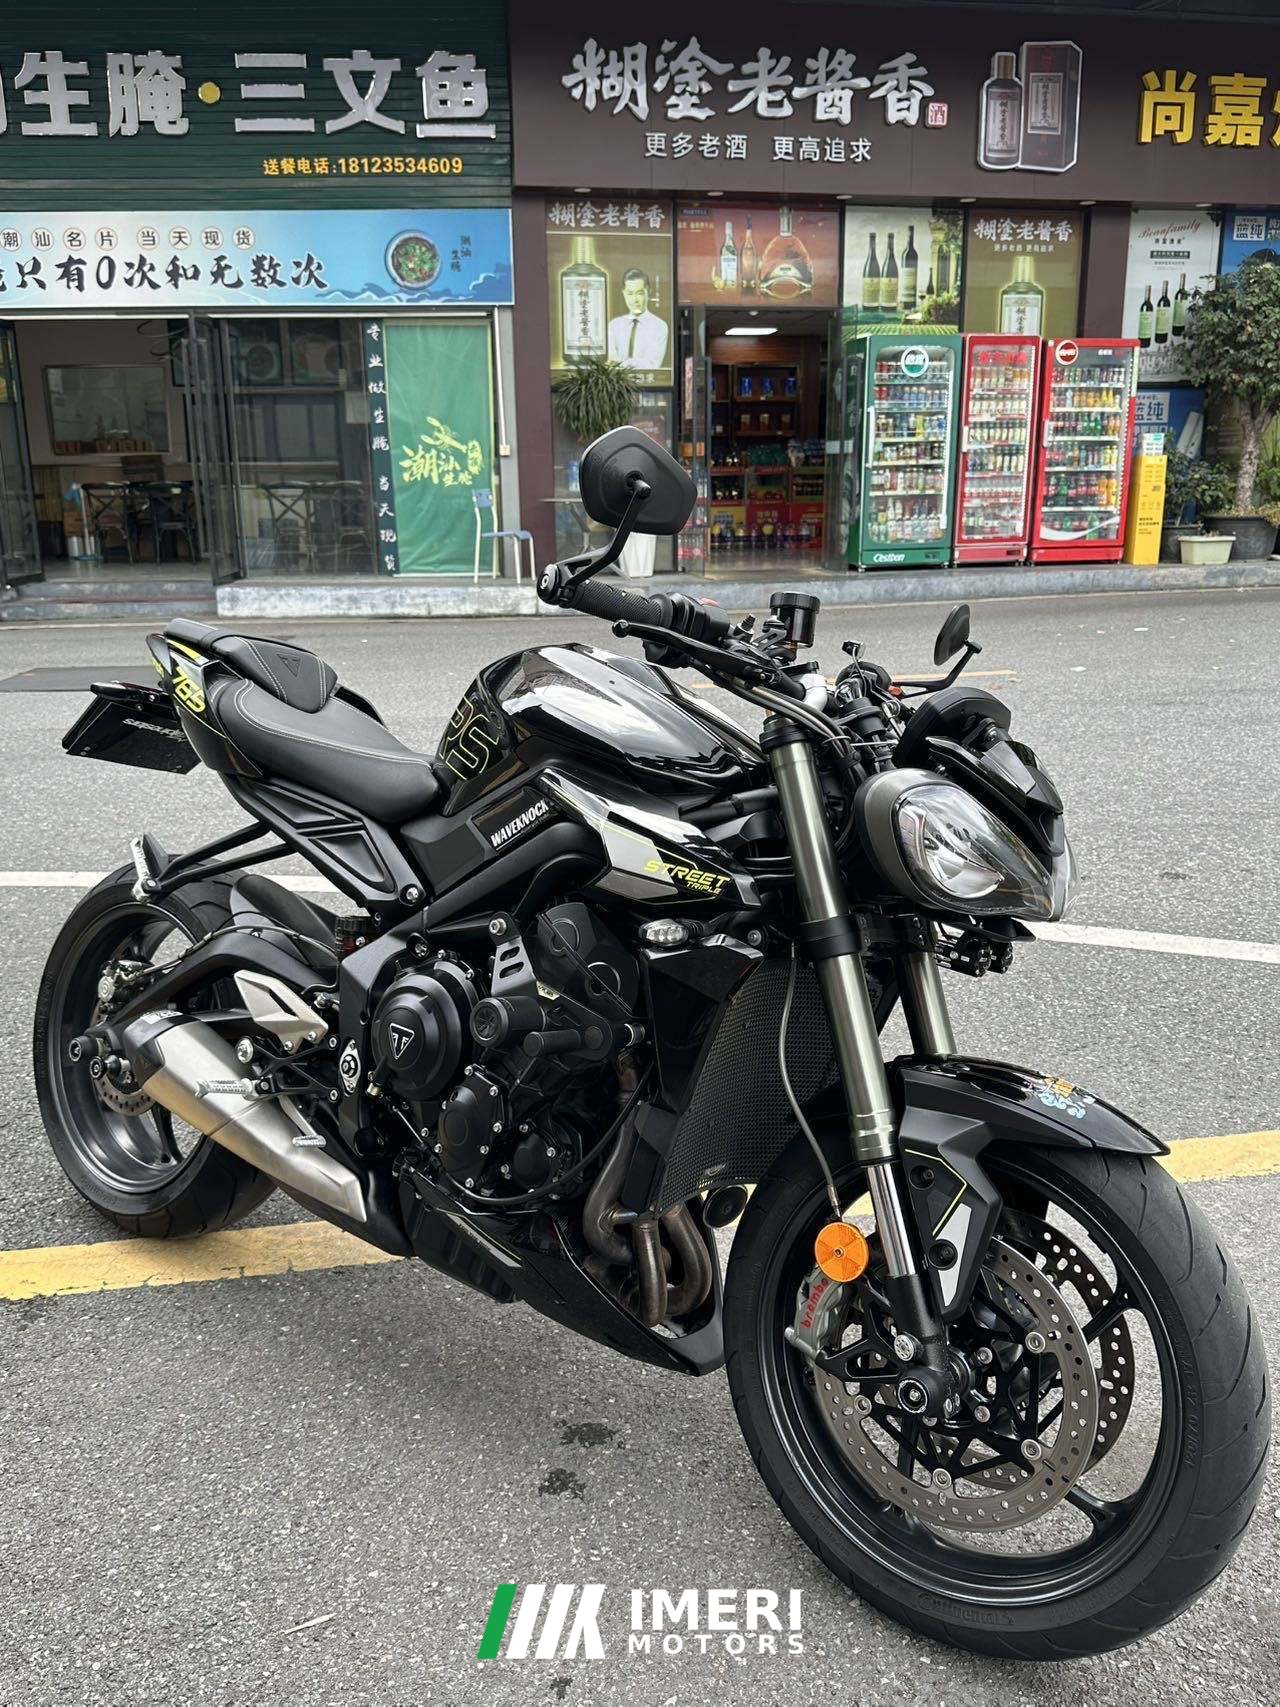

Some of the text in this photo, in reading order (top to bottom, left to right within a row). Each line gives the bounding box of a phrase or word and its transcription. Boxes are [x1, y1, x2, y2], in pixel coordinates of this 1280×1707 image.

[0, 49, 497, 139] 生腌·三文鱼
[1138, 70, 1280, 147] 尚嘉
[644, 132, 873, 163] 更多老酒 更高追求
[2, 231, 252, 247] 潮汕名片 当天现货
[172, 665, 206, 713] 765
[490, 799, 549, 847] WAVEKNOCK
[644, 859, 731, 888] STREET
[686, 882, 723, 895] TRIPLE
[800, 1279, 829, 1329] brembo
